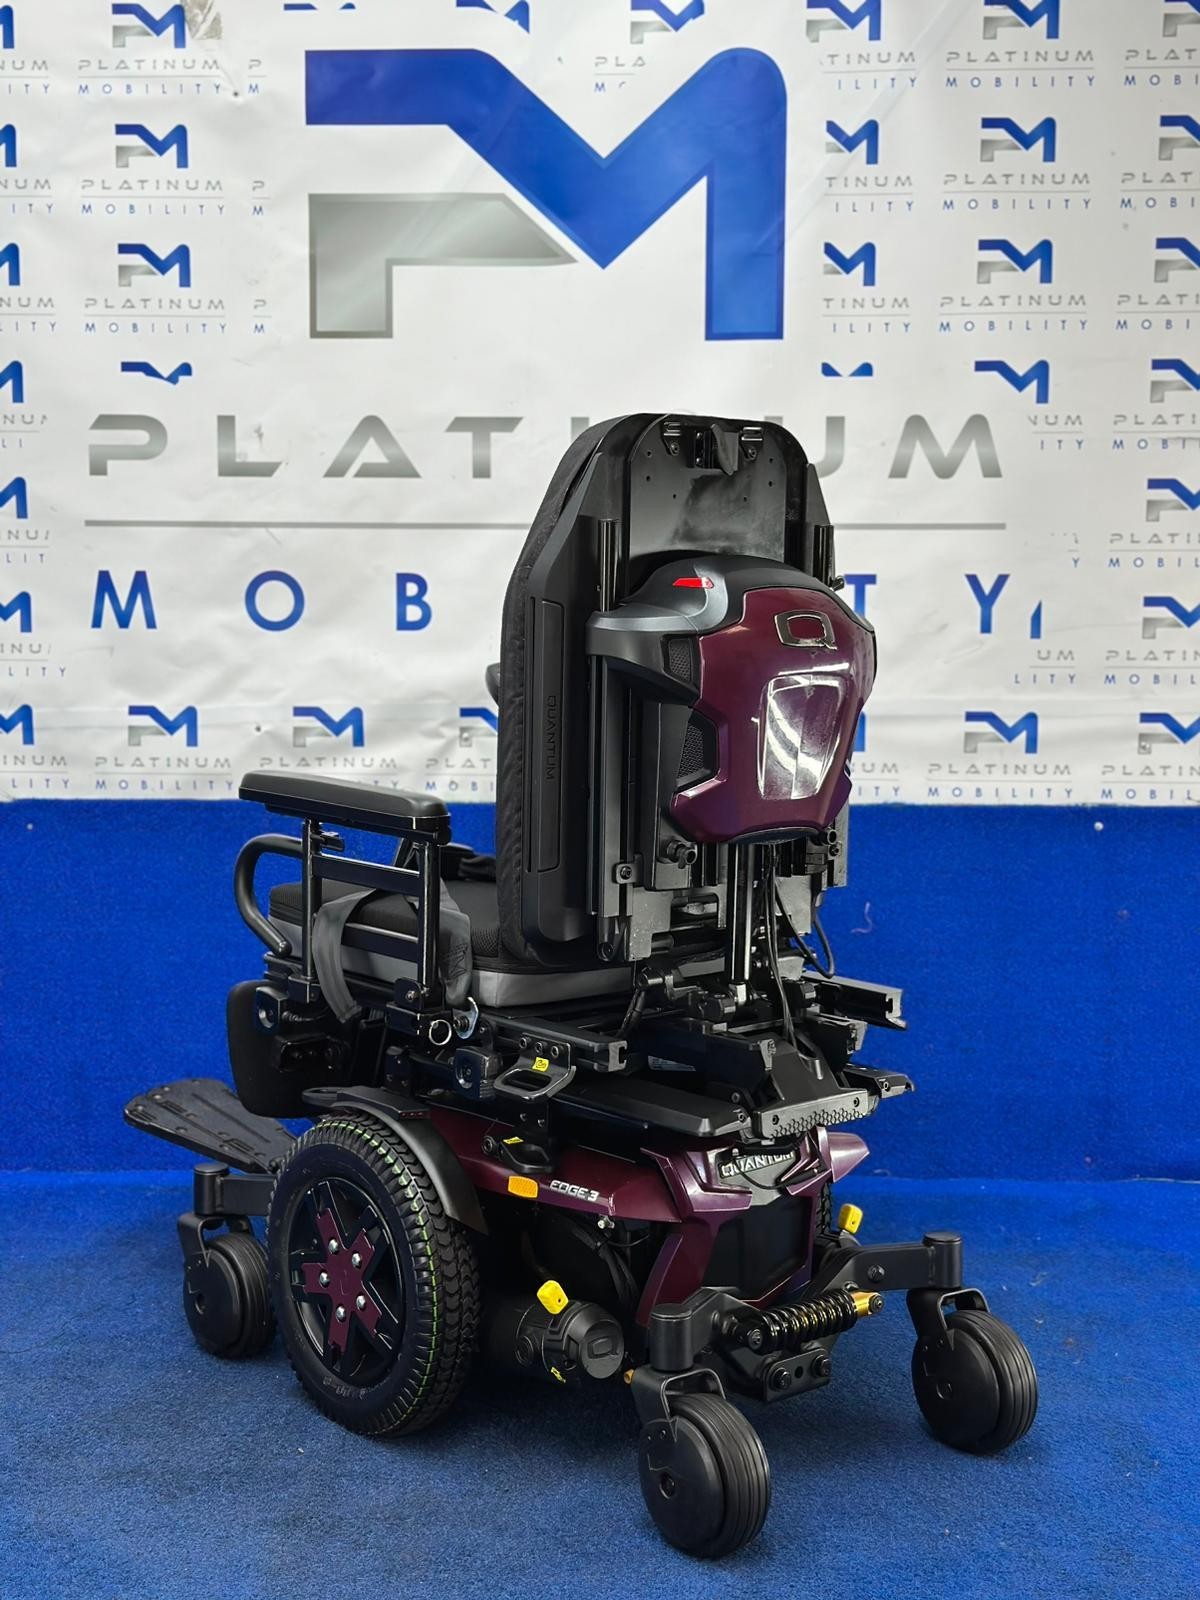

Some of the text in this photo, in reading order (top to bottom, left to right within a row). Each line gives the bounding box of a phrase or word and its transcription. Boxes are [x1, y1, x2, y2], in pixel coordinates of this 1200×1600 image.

[946, 49, 1095, 63] PLATINUM
[77, 58, 220, 71] PLATINUM
[78, 82, 221, 95] MOBILITY
[945, 74, 1096, 89] MOBILITY
[81, 178, 223, 192] PLATINUM
[943, 172, 1091, 186] PLATINUM
[80, 203, 225, 216] MOBILITY
[942, 197, 1092, 211] MOBILITY
[84, 297, 225, 310] PLATINUM
[939, 293, 1087, 308] PLATINUM
[84, 321, 227, 334] MOBILITY
[938, 318, 1089, 333] MOBILITY
[93, 756, 232, 769] PLATINUM
[259, 755, 401, 770] PLATINUM
[927, 762, 1071, 776] PLATINUM
[95, 779, 234, 792] MOBILITY
[927, 786, 1073, 800] MOBILITY
[549, 1179, 589, 1200] EDGE
